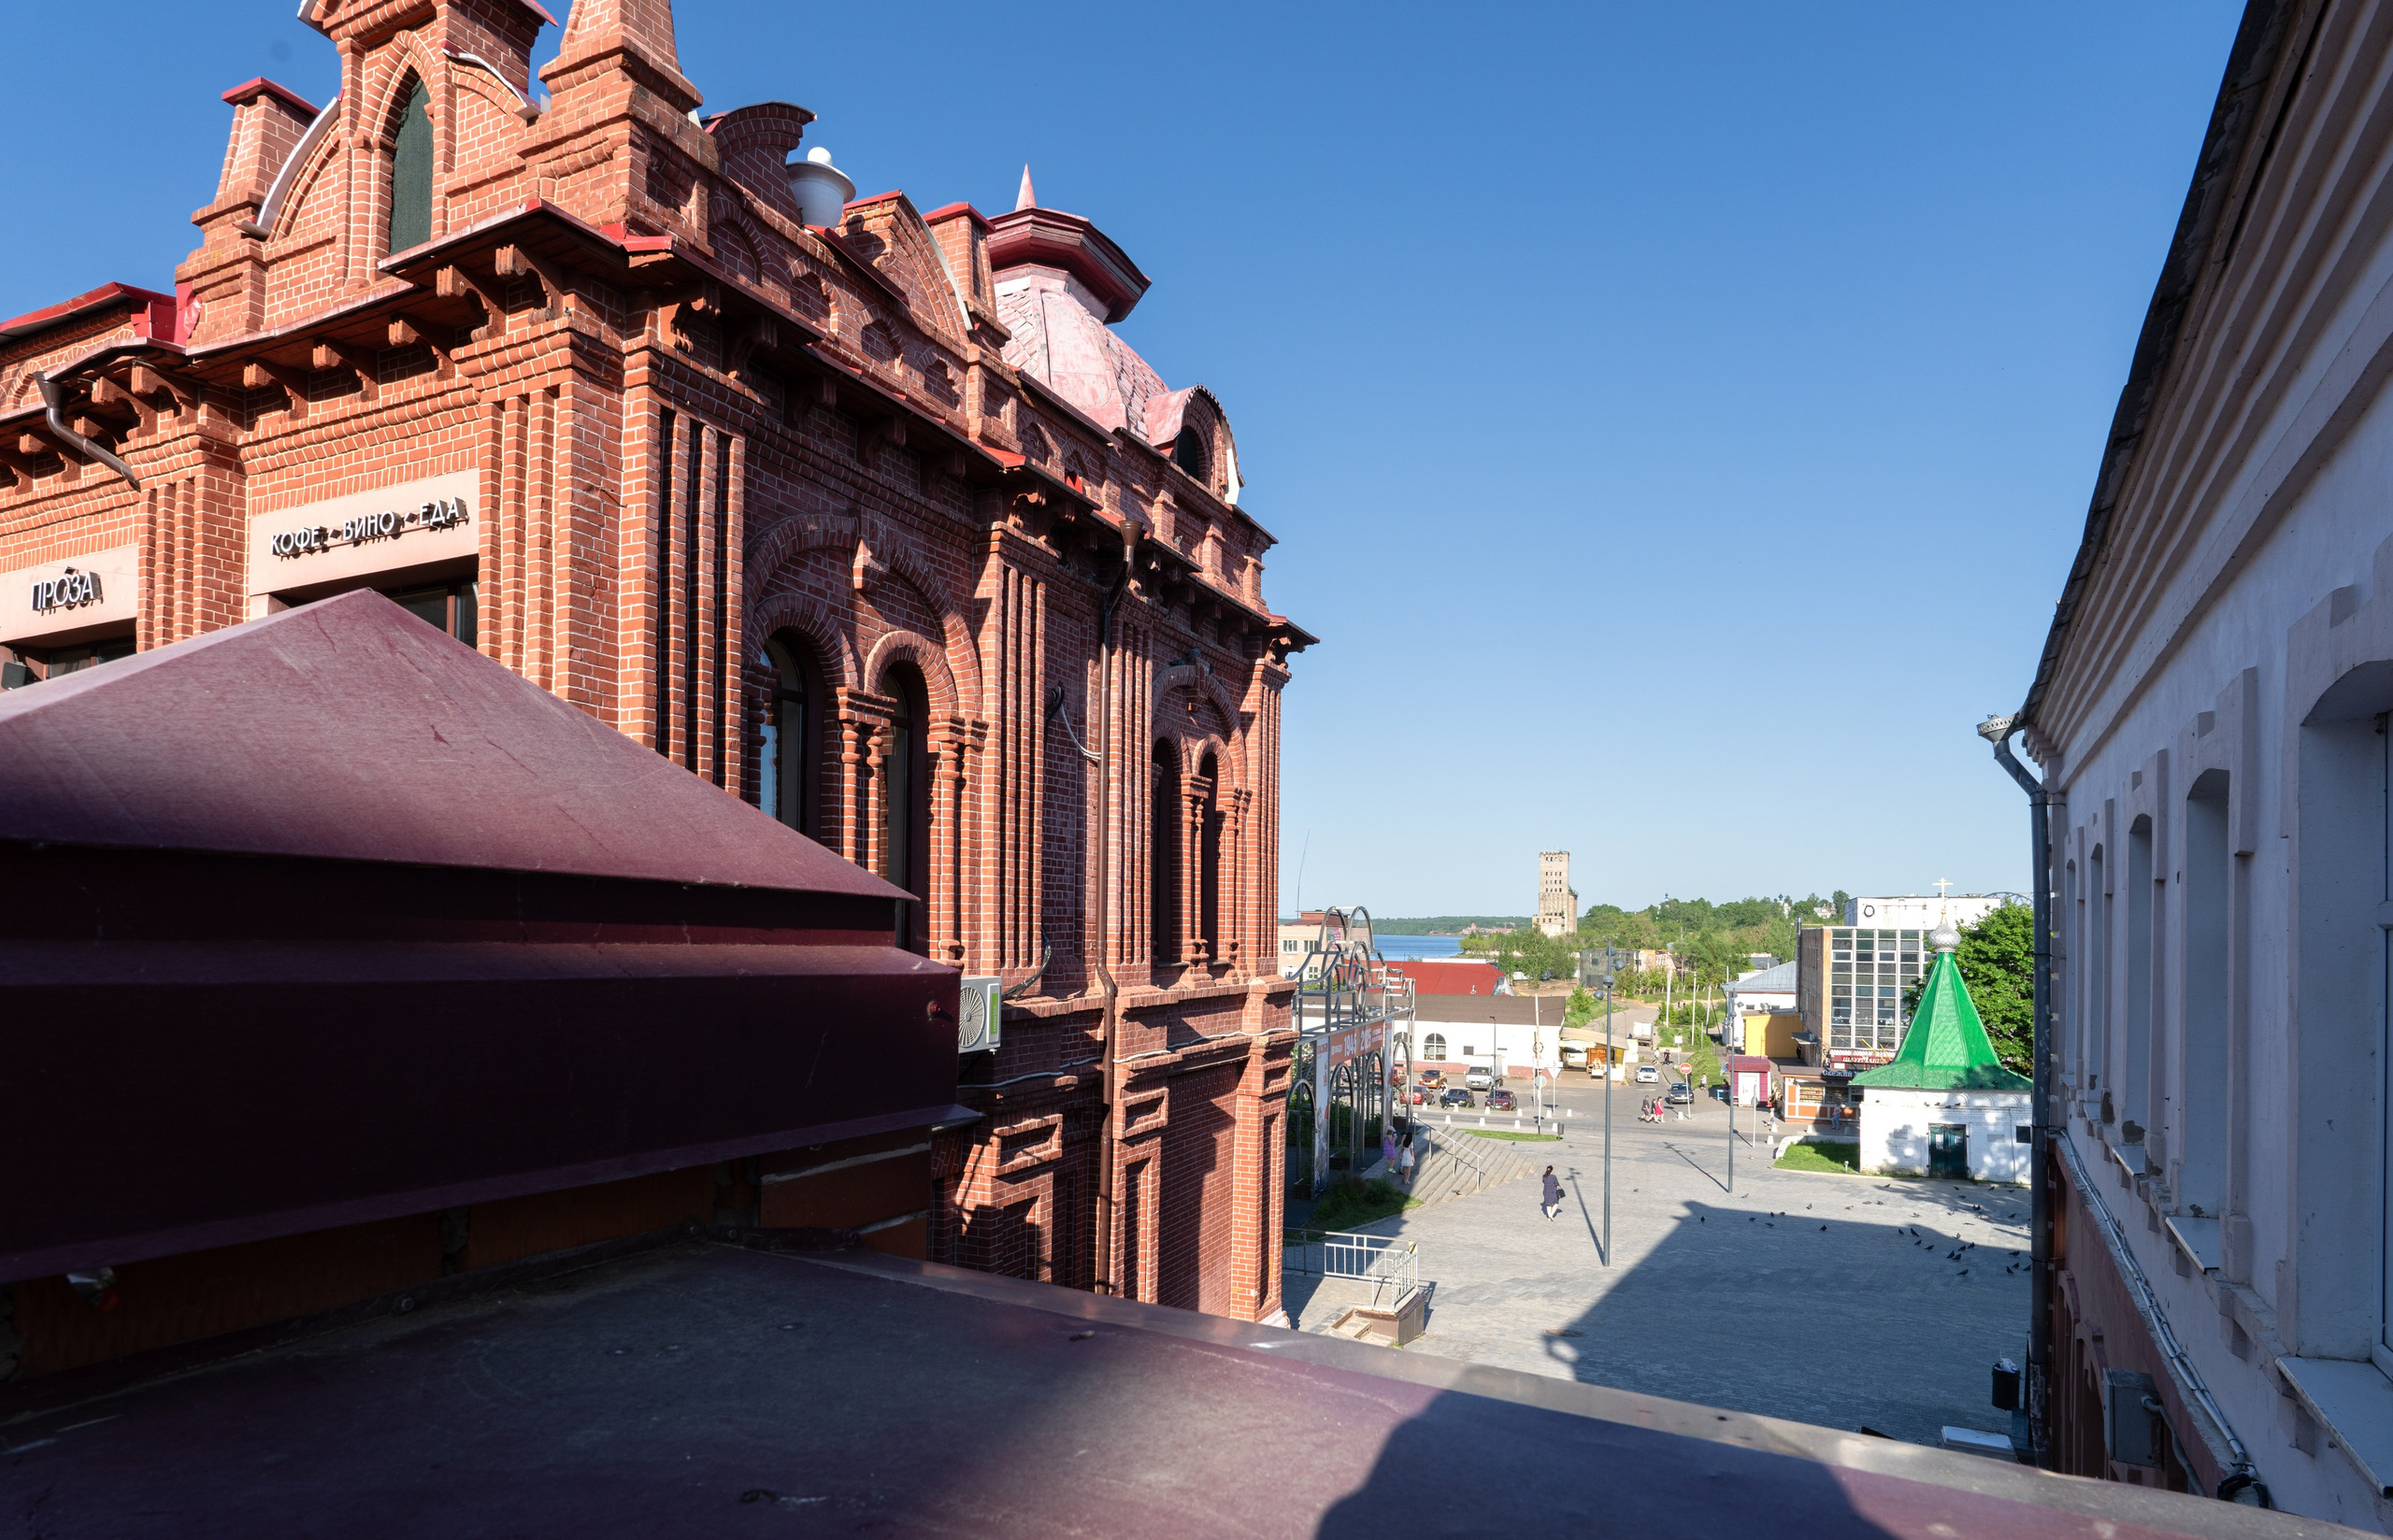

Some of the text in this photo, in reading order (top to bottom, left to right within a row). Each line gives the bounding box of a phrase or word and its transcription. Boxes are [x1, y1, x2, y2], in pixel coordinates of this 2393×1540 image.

[270, 496, 460, 555] КОФЕ ВИНО ЕДА
[30, 566, 94, 610] ПРОЗА
